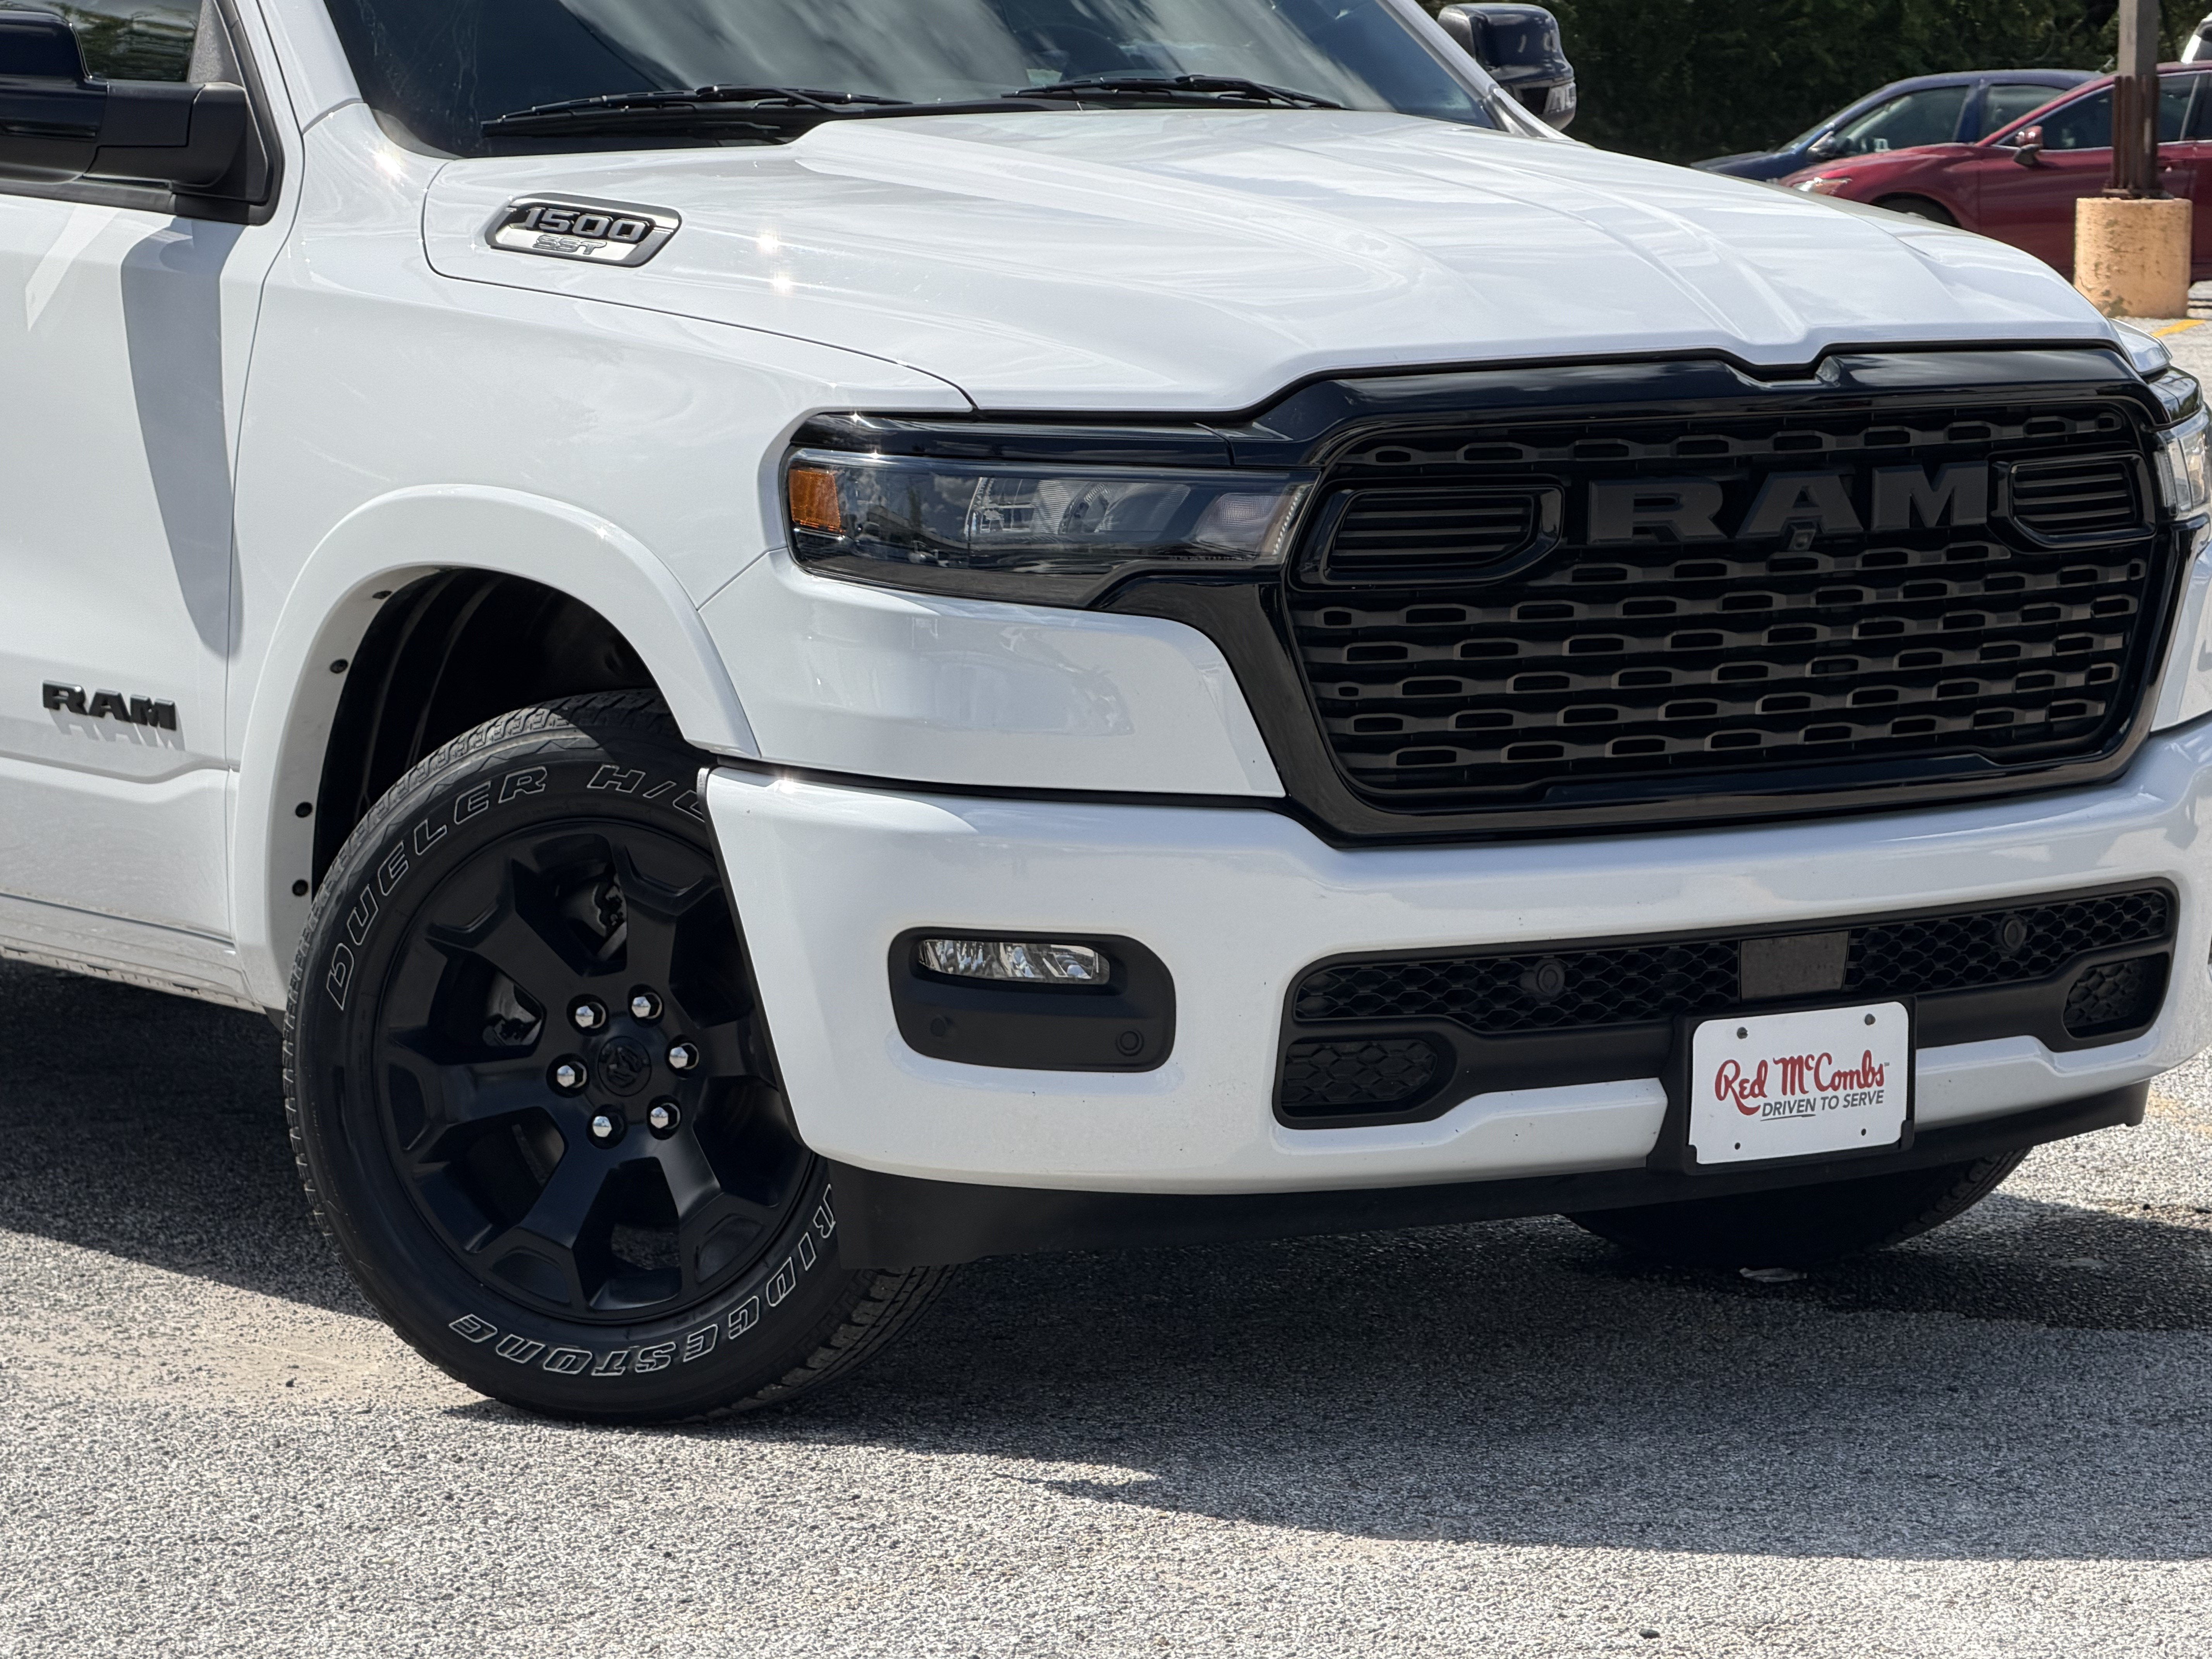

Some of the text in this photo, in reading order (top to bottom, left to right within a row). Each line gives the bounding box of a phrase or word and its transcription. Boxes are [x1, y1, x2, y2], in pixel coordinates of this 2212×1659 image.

[526, 206, 649, 241] 1500
[532, 234, 607, 255] SST
[1586, 460, 1989, 544] RAM
[42, 680, 177, 731] RAM
[326, 766, 548, 1010] DUELER
[1714, 1049, 1885, 1116] Red McCombs
[1762, 1089, 1885, 1117] DRIVEN TO SERVE
[448, 1183, 836, 1376] RIDGESTONE
